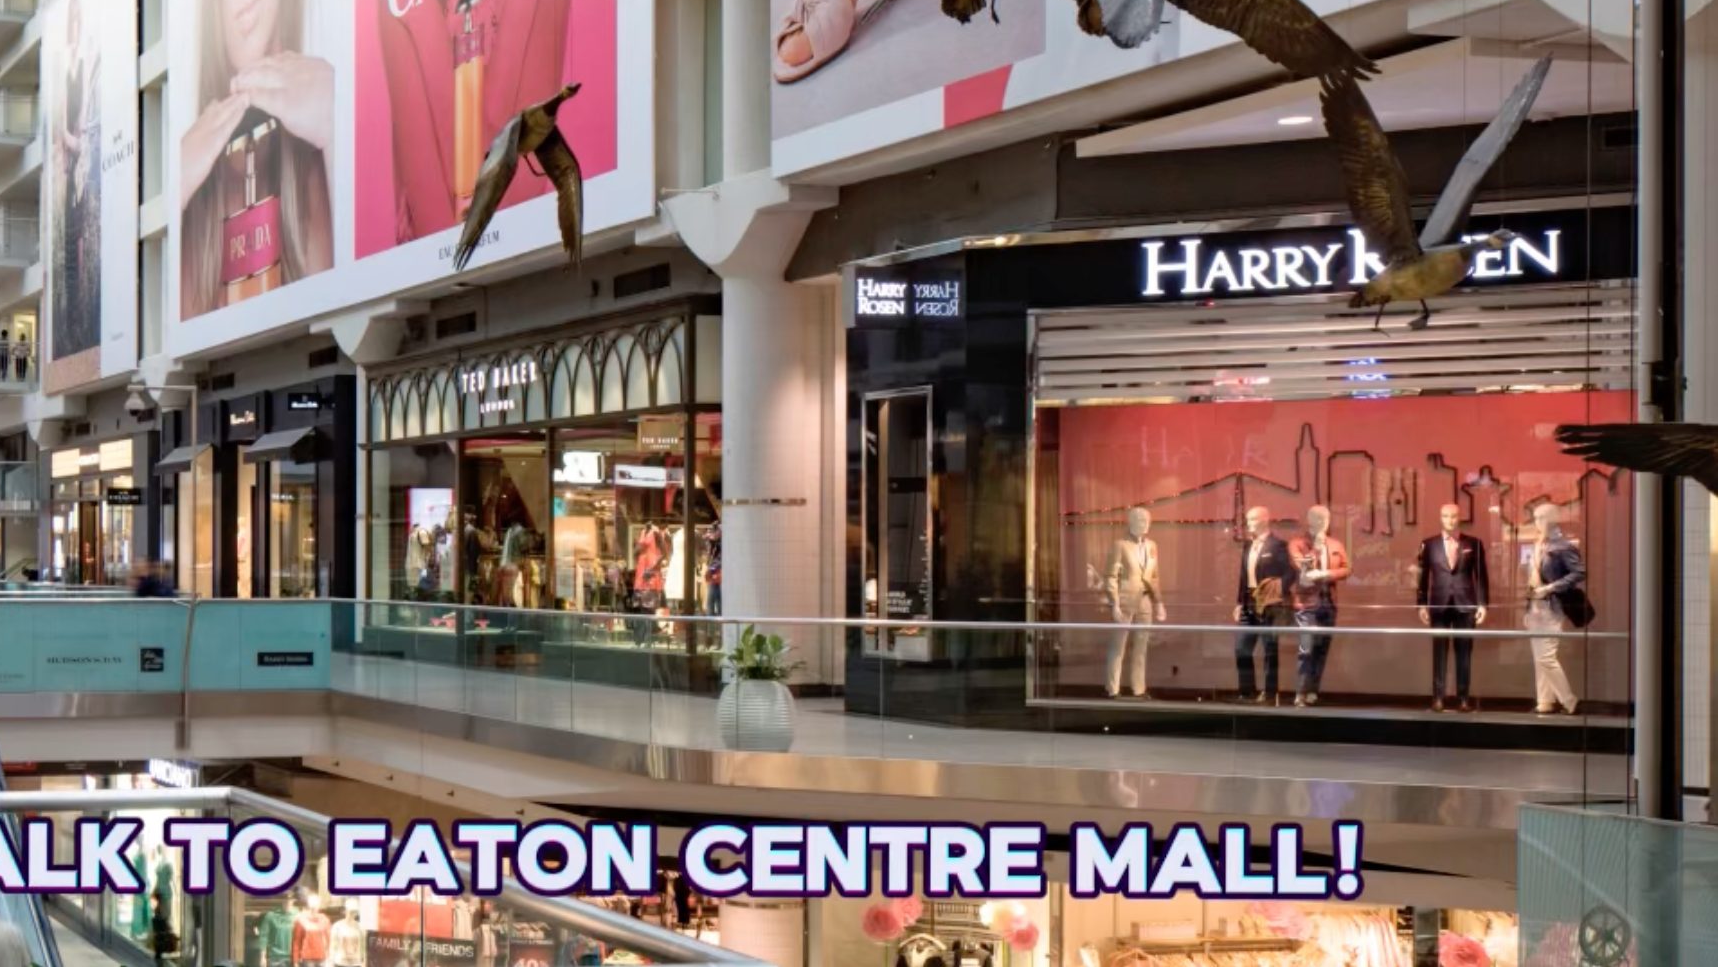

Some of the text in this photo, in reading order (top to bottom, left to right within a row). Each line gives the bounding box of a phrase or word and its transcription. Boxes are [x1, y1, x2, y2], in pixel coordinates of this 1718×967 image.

[1141, 228, 1562, 294] HARRY REN
[857, 278, 907, 298] HARRY
[857, 296, 906, 315] ROSEN
[462, 370, 485, 394] TED
[426, 938, 475, 957] FRIENDS
